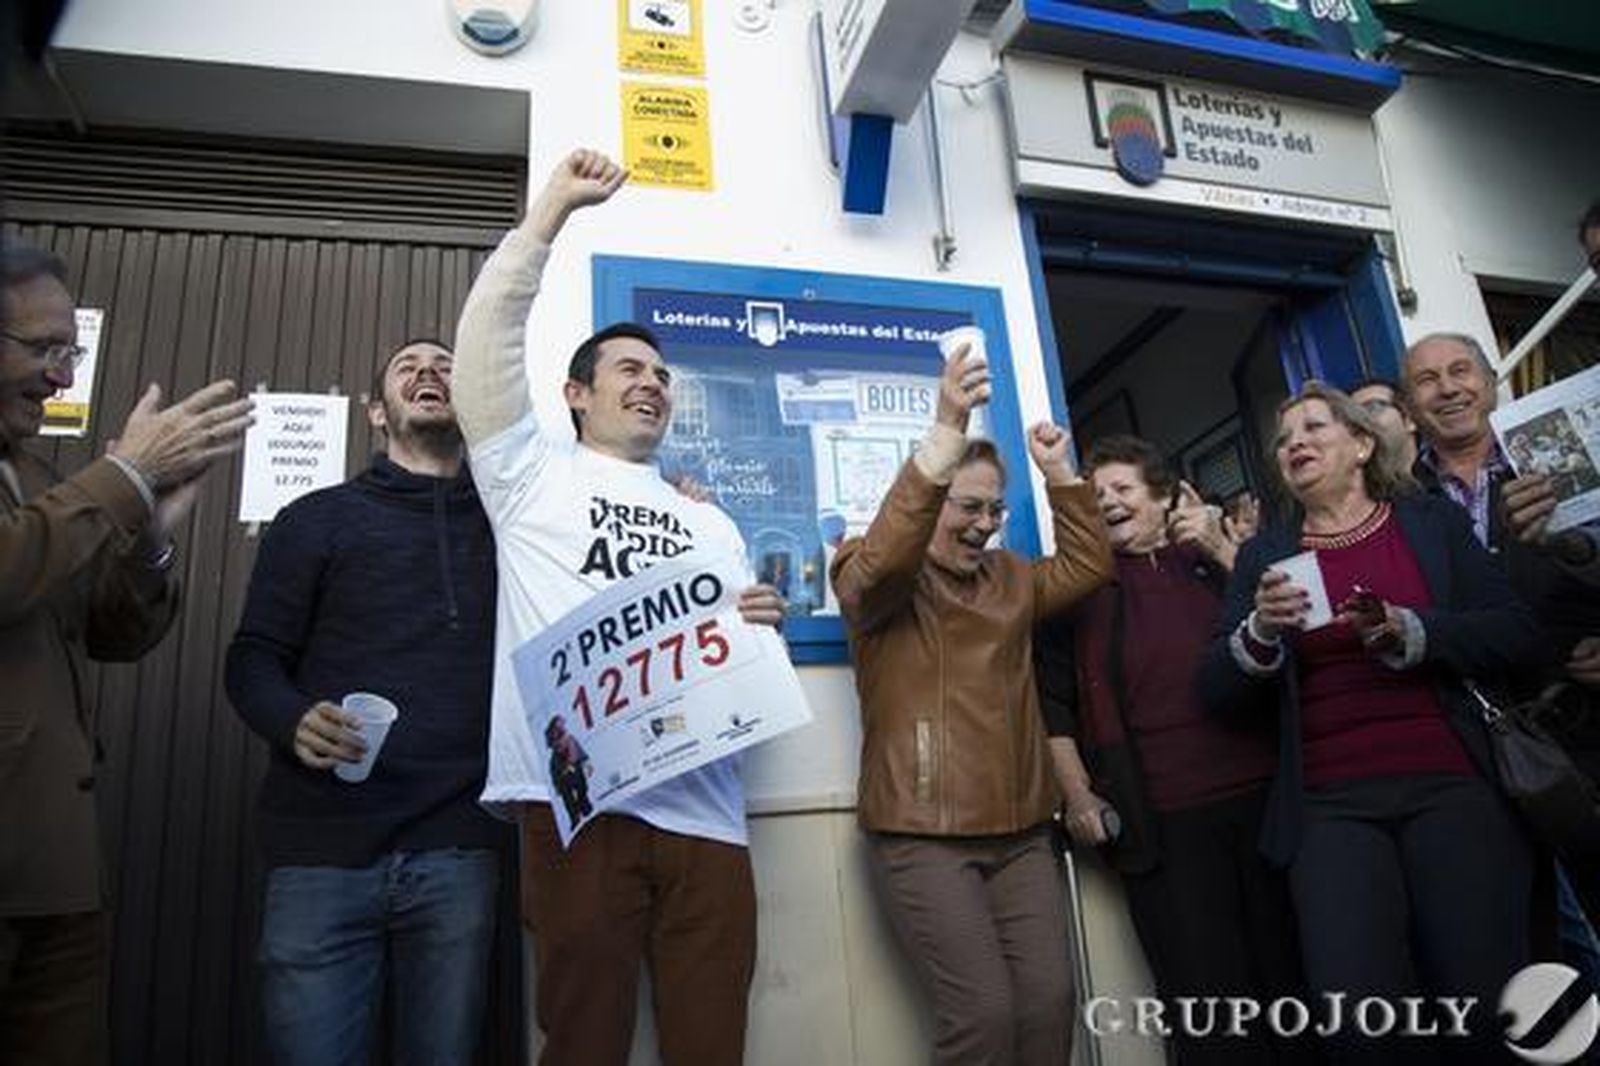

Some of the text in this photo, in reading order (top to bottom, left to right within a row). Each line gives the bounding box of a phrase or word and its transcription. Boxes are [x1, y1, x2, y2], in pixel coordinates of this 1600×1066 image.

[1269, 106, 1282, 127] y
[1182, 116, 1314, 154] Apuestas del
[1185, 142, 1260, 171] Estado
[736, 318, 749, 332] y
[785, 319, 868, 337] Apuestas
[872, 325, 899, 340] del
[902, 326, 953, 342] Esta
[868, 385, 930, 413] BOTES
[577, 573, 723, 667] PREMIO
[572, 618, 730, 730] 12775
